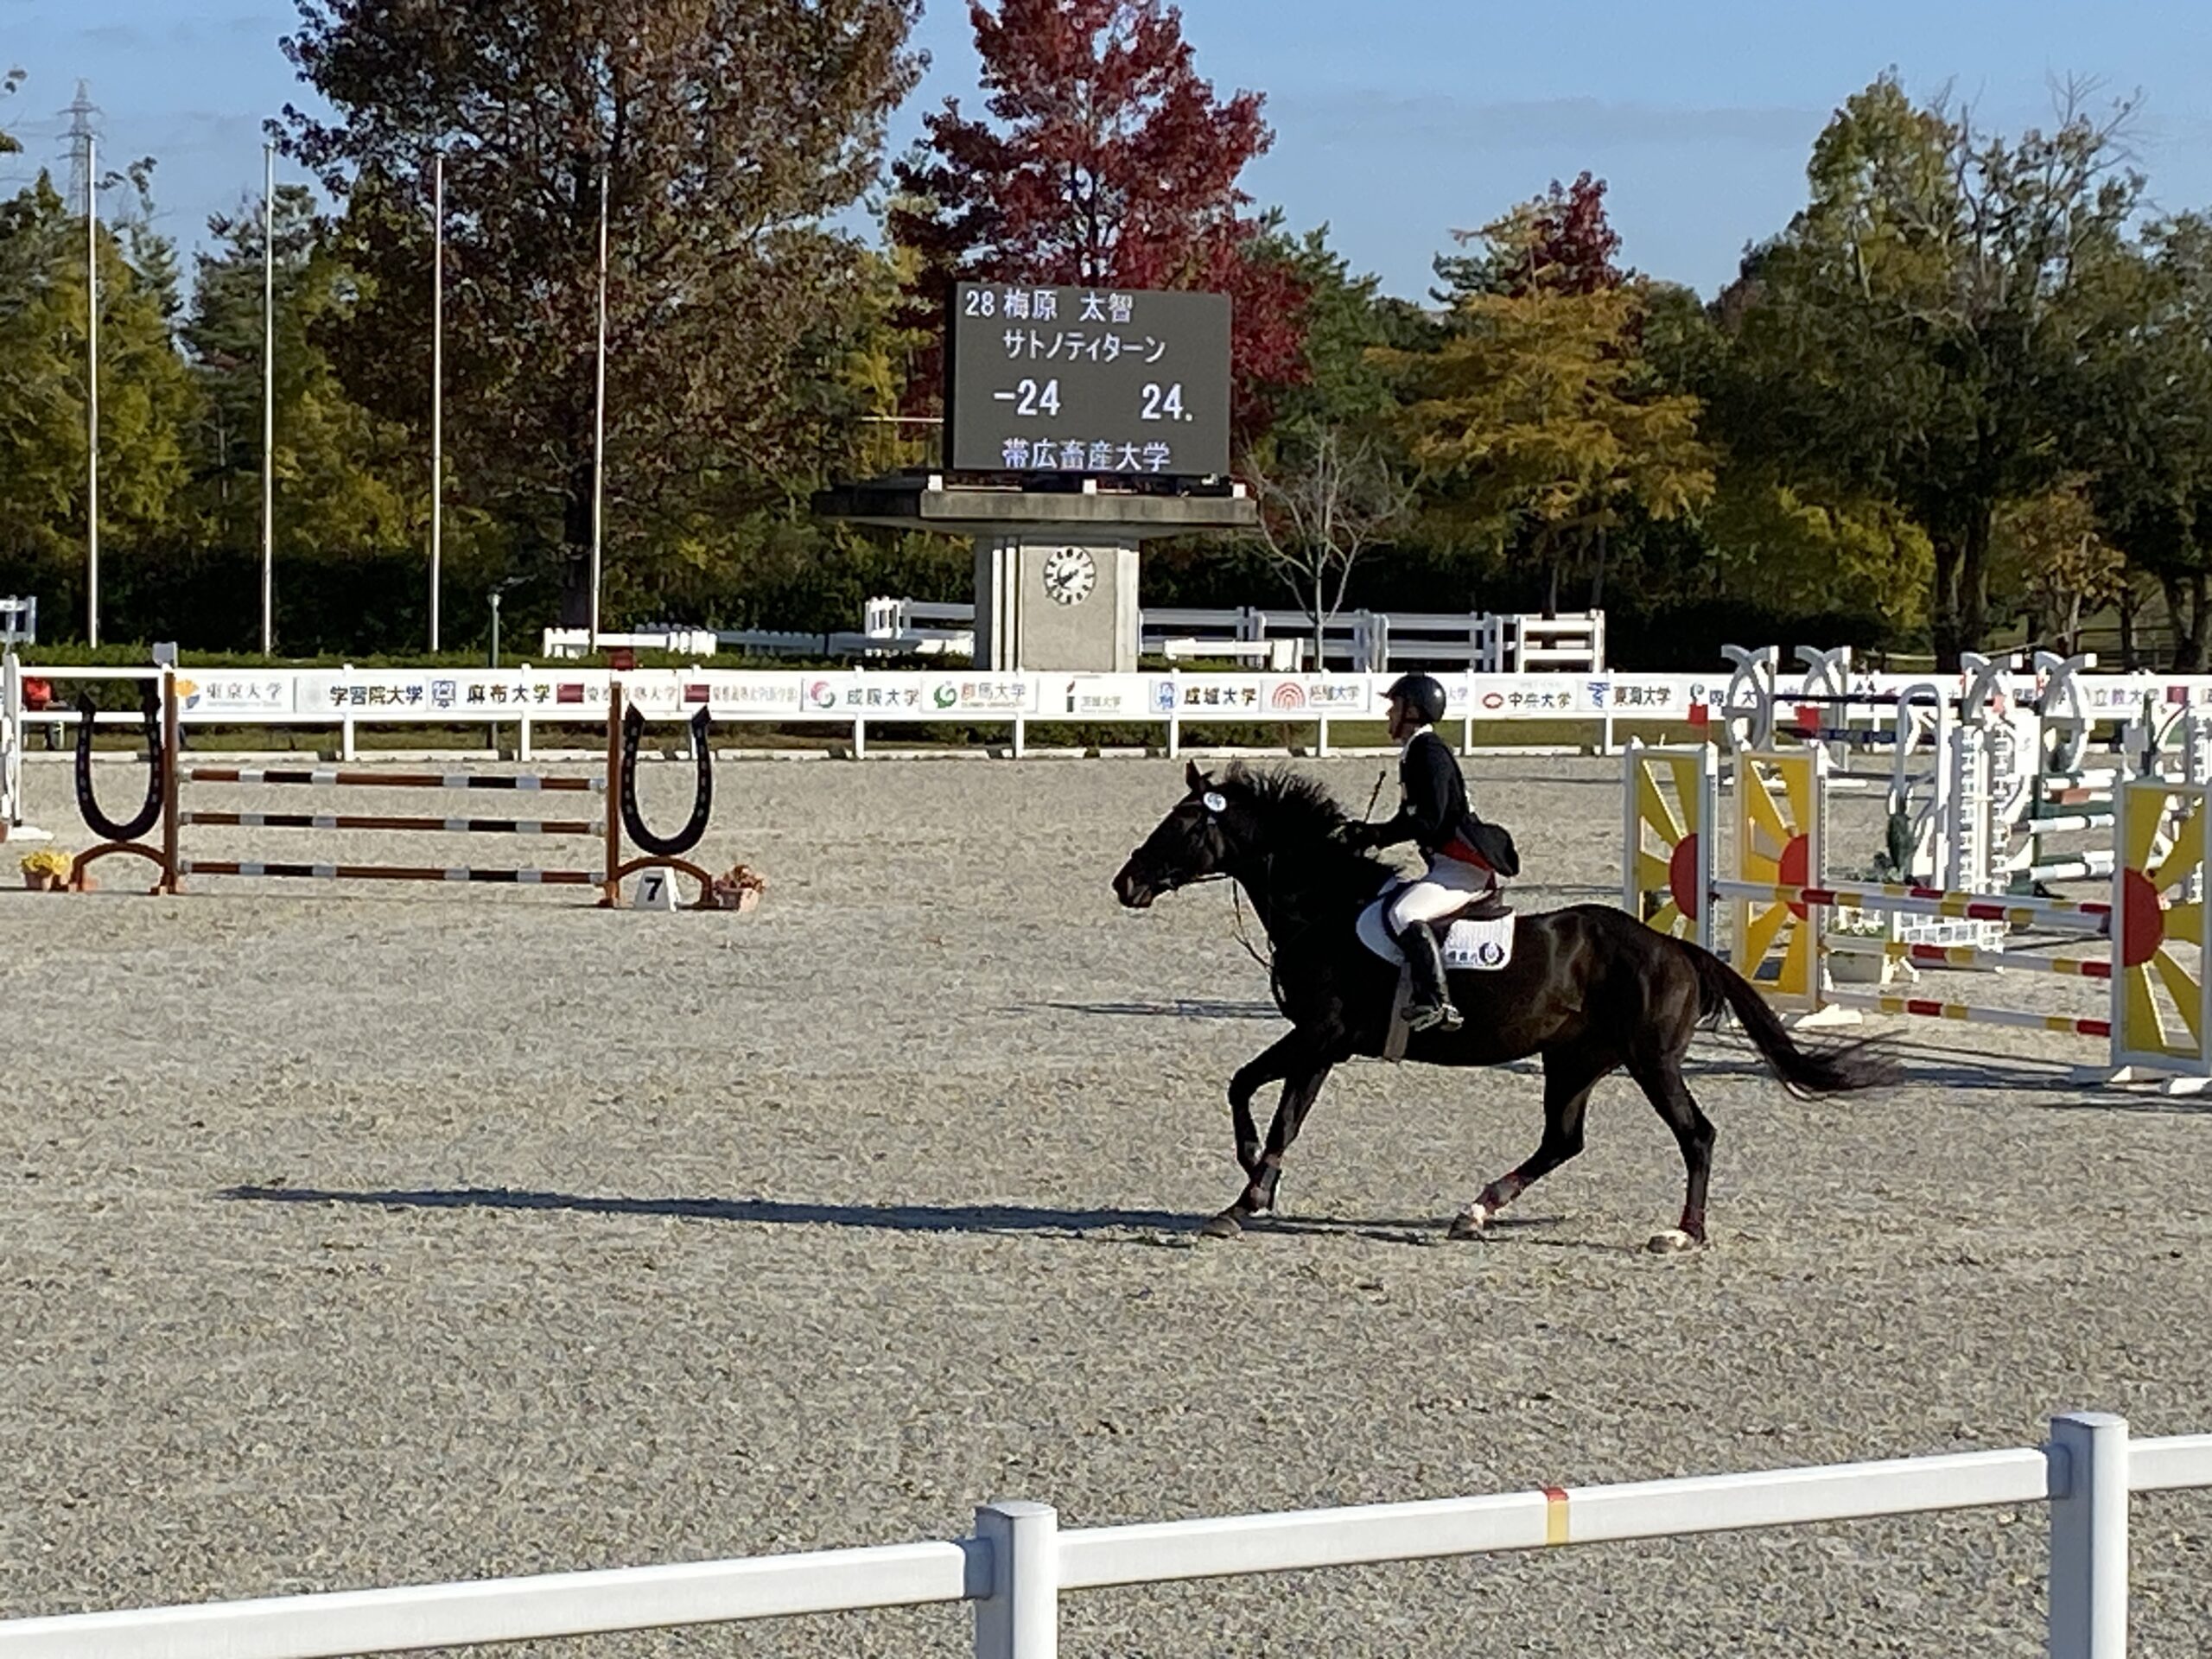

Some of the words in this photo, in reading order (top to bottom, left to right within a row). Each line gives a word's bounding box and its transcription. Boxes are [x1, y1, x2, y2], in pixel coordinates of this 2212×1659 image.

[965, 289, 995, 317] 28
[1002, 288, 1058, 321] 梅原
[1078, 291, 1134, 323] 太智
[1002, 328, 1166, 364] サトノティターン
[1001, 437, 1171, 473] 帯広畜産大学
[207, 682, 283, 701] 東京大学
[330, 684, 423, 706] 学習院大学
[466, 683, 551, 704] 麻布大学
[961, 682, 1027, 701] 群馬大学
[1184, 687, 1257, 706] 成城大学
[1508, 691, 1573, 709] 中央大学
[1613, 685, 1671, 707] 東海大学
[645, 876, 663, 902] 7
